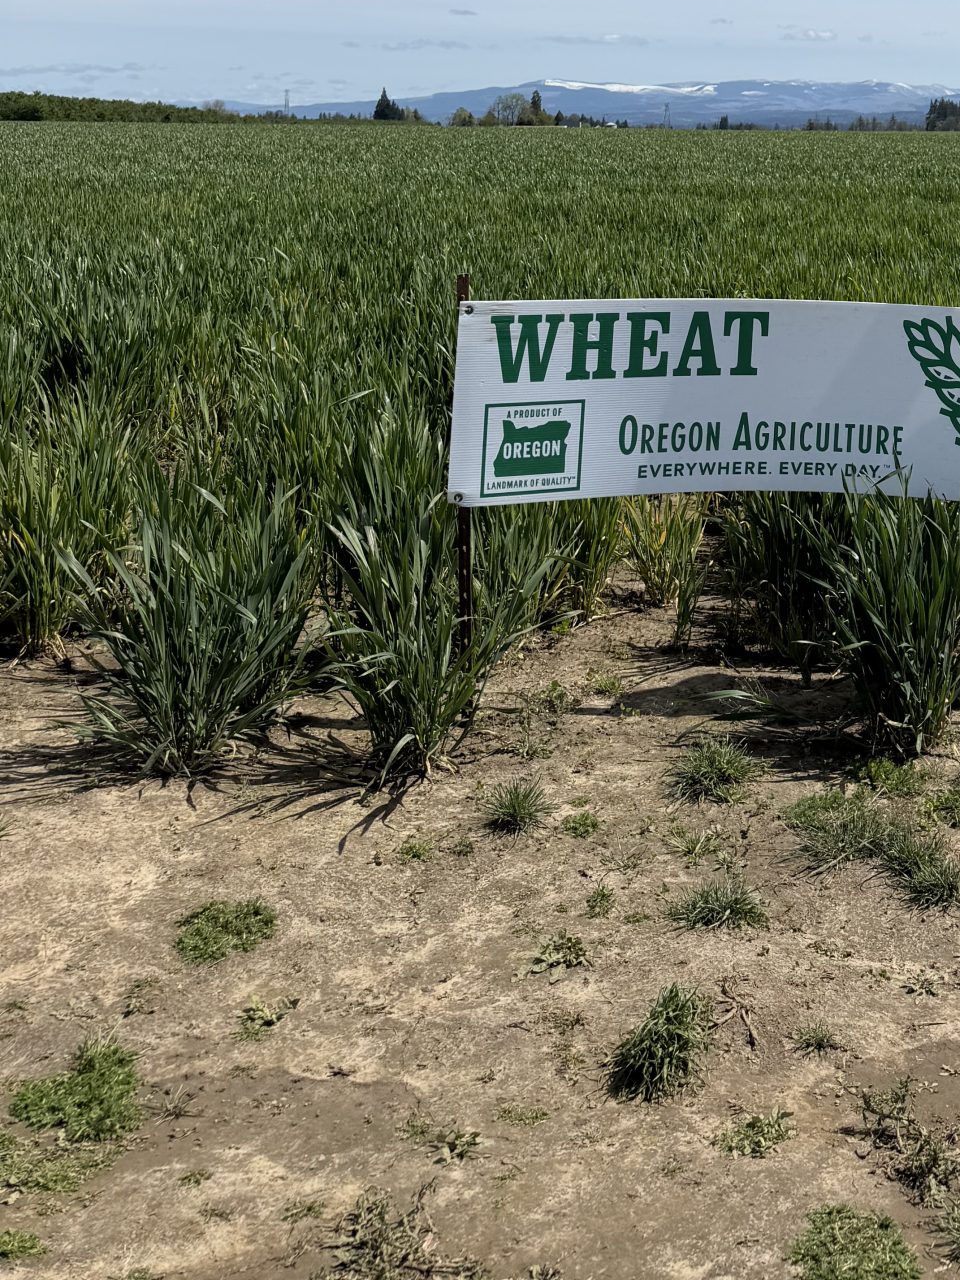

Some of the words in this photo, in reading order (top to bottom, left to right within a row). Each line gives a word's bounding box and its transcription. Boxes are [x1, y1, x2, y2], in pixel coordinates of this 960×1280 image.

[490, 311, 770, 383] WHEAT
[507, 410, 512, 419] A
[513, 408, 550, 419] PRODUCT
[552, 407, 562, 417] OF
[503, 439, 560, 459] OREGON
[637, 461, 772, 479] EVERYWHERE.
[779, 461, 838, 476] EVERY
[486, 480, 528, 490] LANDMARK
[530, 478, 540, 488] OF
